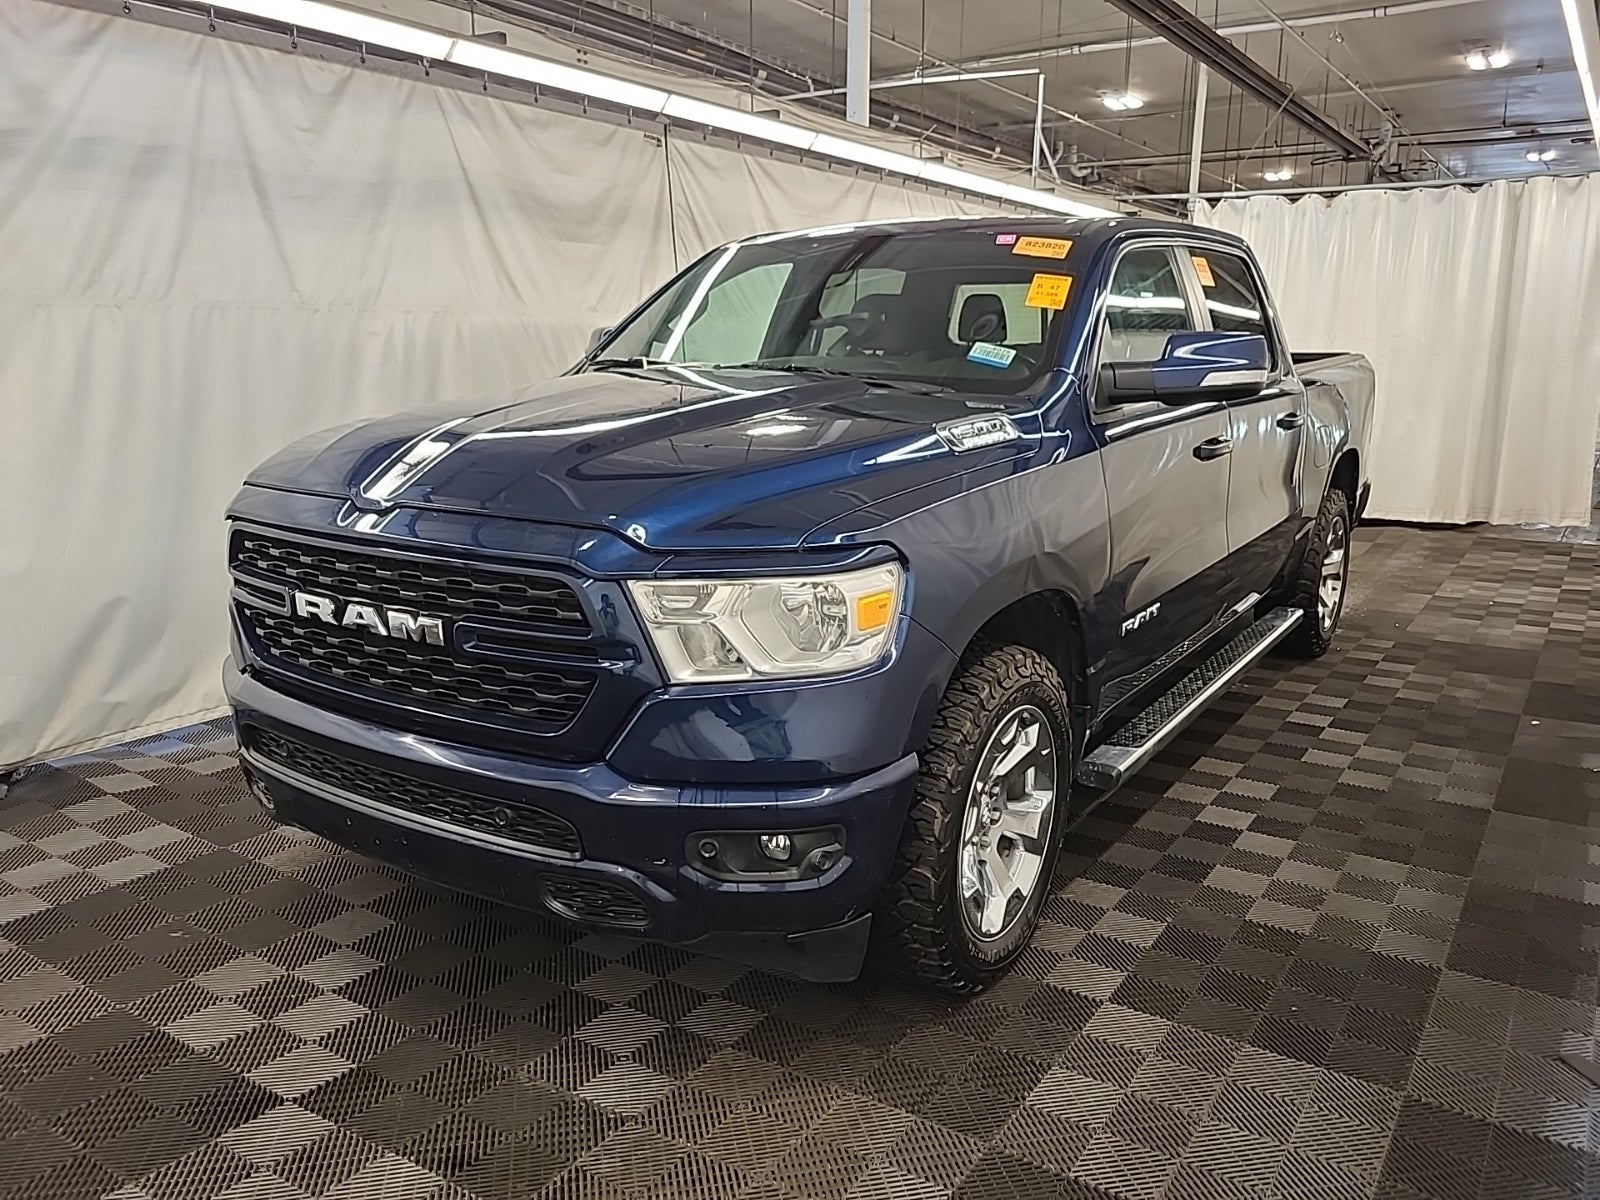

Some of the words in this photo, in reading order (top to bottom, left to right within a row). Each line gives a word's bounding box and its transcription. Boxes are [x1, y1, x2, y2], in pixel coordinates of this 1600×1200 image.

[1025, 241, 1066, 250] 823820
[295, 591, 445, 646] RAM
[1121, 602, 1161, 637] RAM
